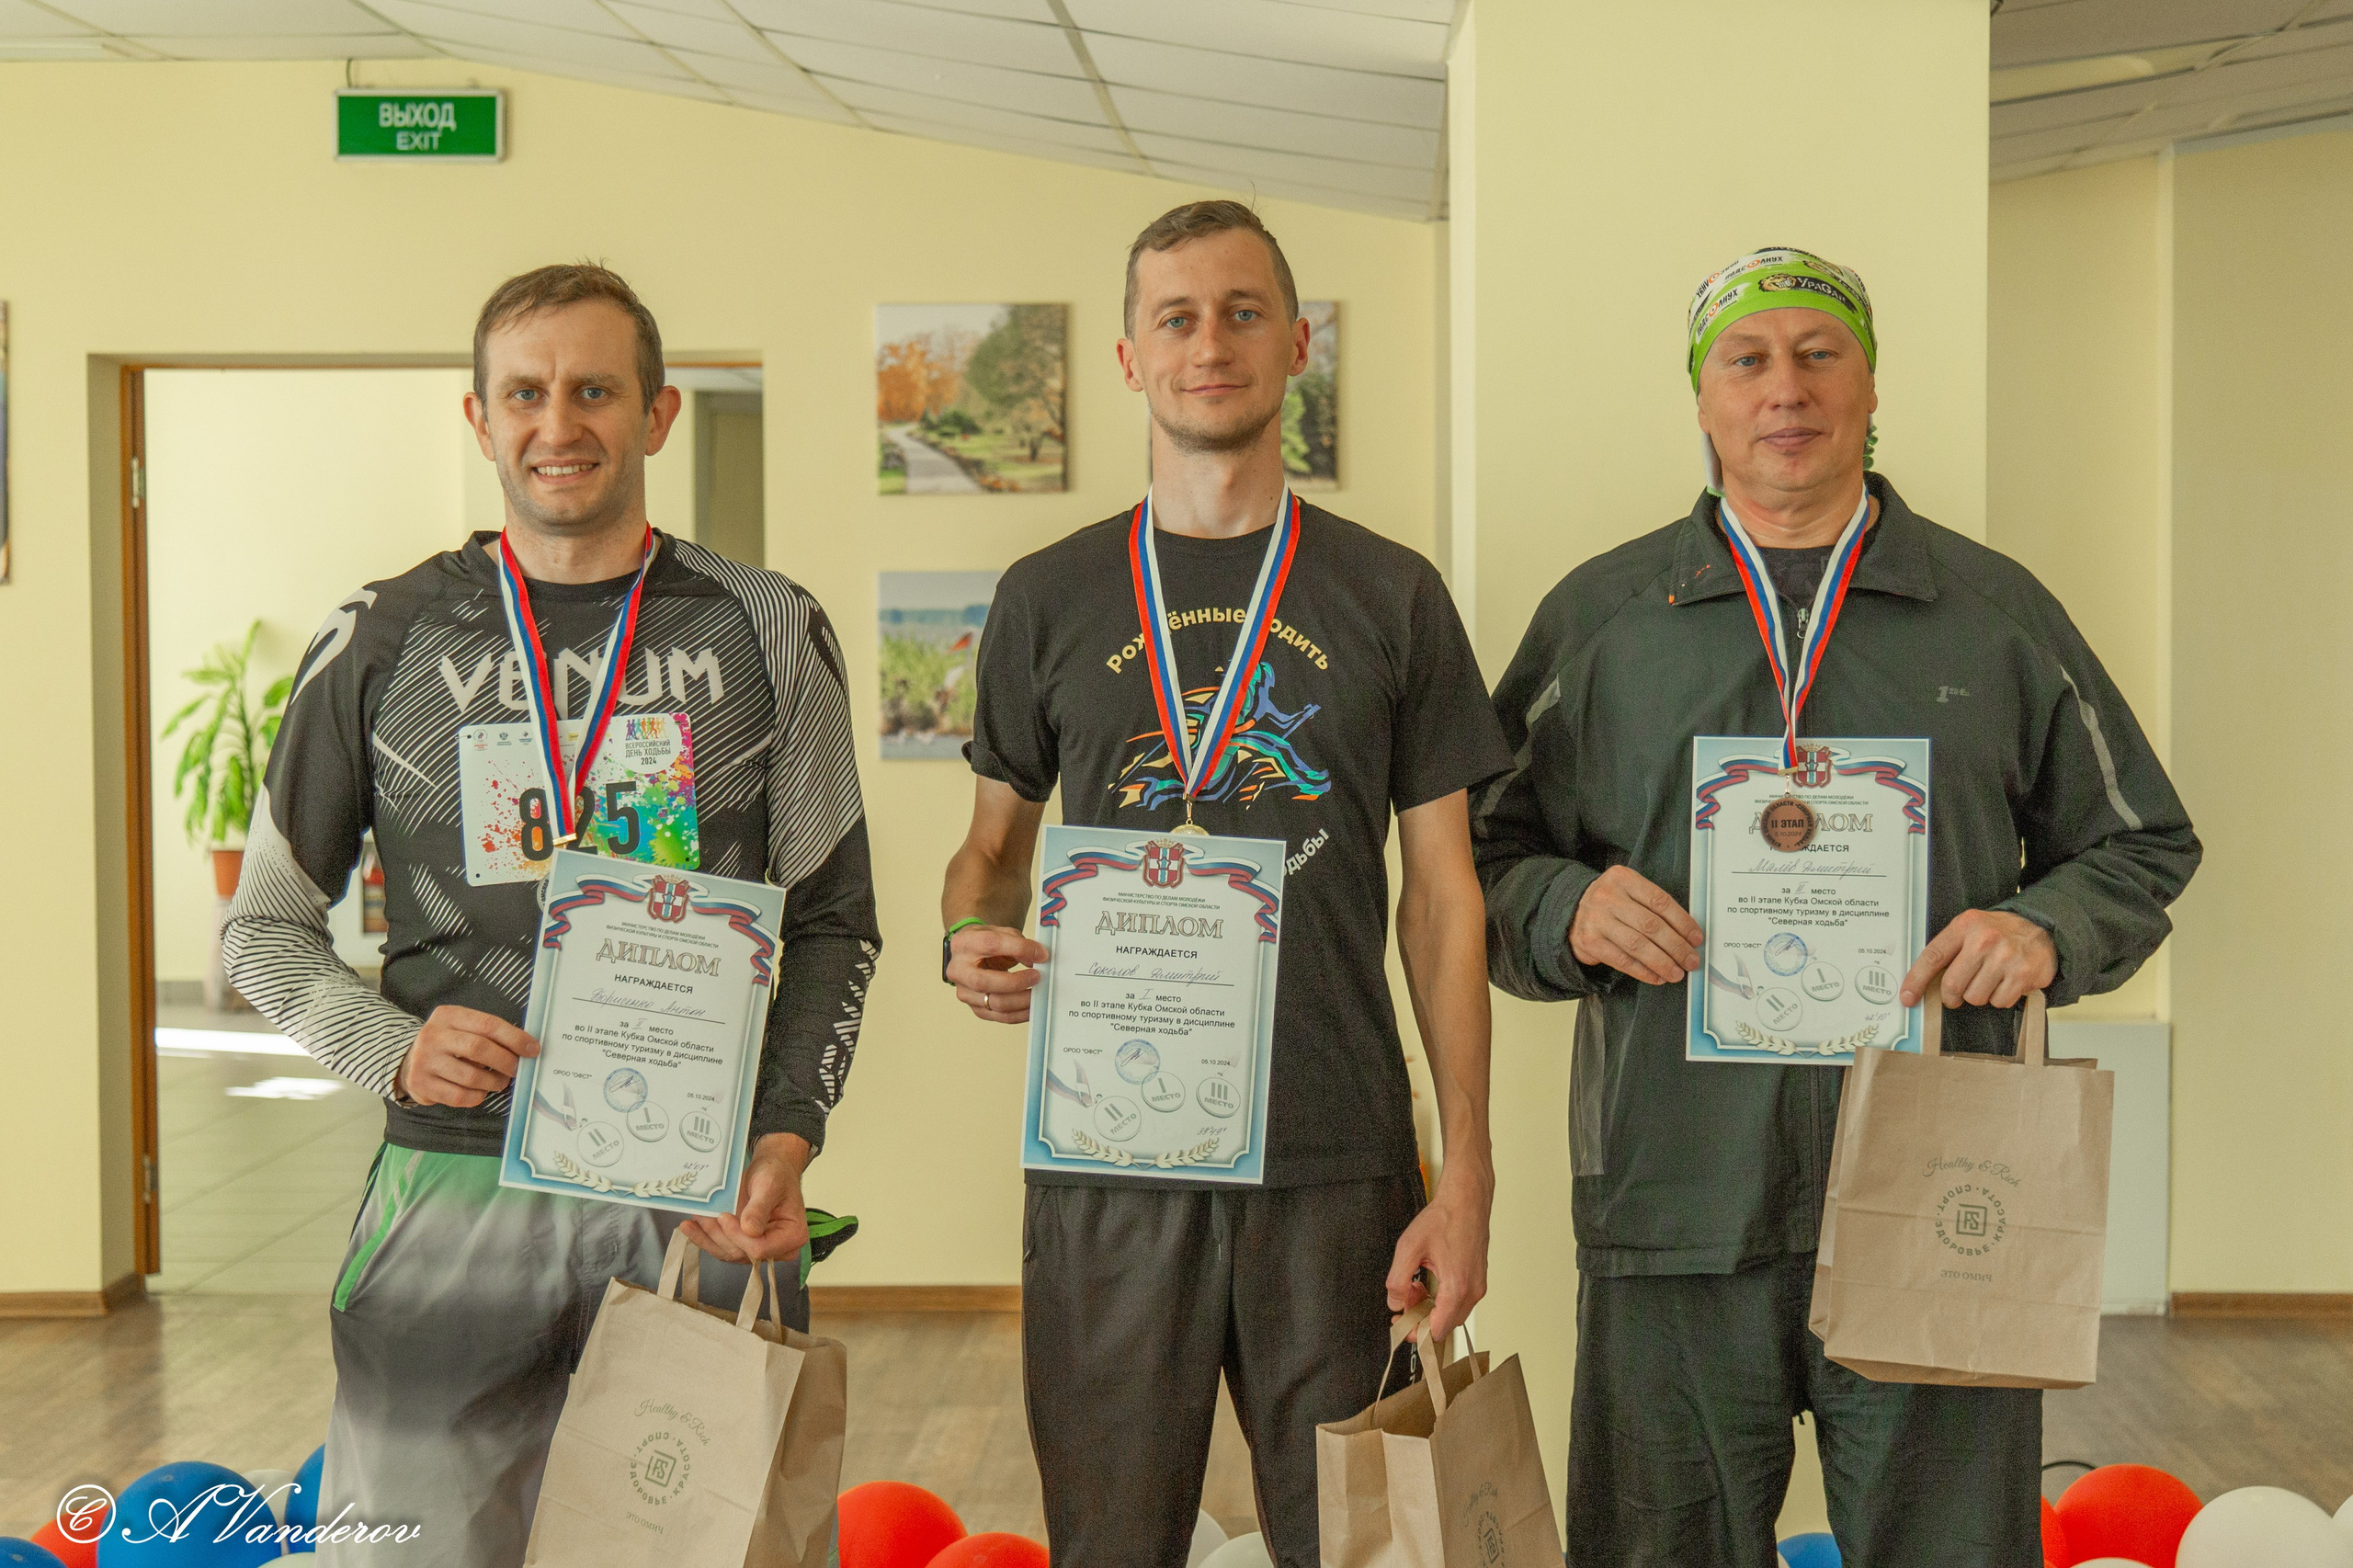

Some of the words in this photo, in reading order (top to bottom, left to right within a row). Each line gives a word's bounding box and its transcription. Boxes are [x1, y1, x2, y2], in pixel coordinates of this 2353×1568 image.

[379, 102, 457, 131] ВЫХОД
[396, 131, 442, 151] EXIT
[1270, 618, 1329, 671] одить
[625, 739, 671, 749] ВСЕРОССИЙСКИЙ
[625, 749, 642, 757] ДЕНЬ
[643, 747, 671, 756] ХОДЬБЫ
[641, 756, 657, 765] 2024
[519, 781, 641, 861] 825
[1748, 810, 1873, 835] ДЛОМ
[1771, 820, 1778, 829] II
[1780, 819, 1804, 829] ЭТАП
[1284, 828, 1329, 876] дьбы
[1784, 896, 1808, 905] Кубка
[1810, 897, 1842, 905] Омской
[1844, 898, 1879, 906] области
[1739, 907, 1793, 915] спортивному
[1796, 908, 1829, 916] туризму
[606, 925, 635, 933] ФИЗИЧЕСКОЙ
[1094, 910, 1224, 939] ДИПЛОМ
[1768, 916, 1813, 926] "Северная
[1814, 918, 1847, 926] ходьба"
[621, 921, 656, 931] МИНИСТЕРСТВО
[679, 932, 705, 940] МОЛОДЁЖИ
[595, 937, 722, 977] ДИПЛОМ
[1116, 945, 1197, 959] НАГРАЖДАЕТСЯ
[614, 973, 693, 994] НАГРАЖДАЕТСЯ
[1811, 981, 1840, 992] МЕСТО
[1862, 983, 1893, 995] МЕСТО
[1093, 999, 1098, 1007] II
[1127, 1002, 1152, 1012] Кубка
[1154, 1004, 1188, 1013] Омской
[1189, 1006, 1224, 1016] области
[1772, 1002, 1798, 1025] МЕСТО
[1081, 1011, 1137, 1022] спортивному
[1140, 1015, 1174, 1025] туризму
[1183, 1018, 1235, 1028] дисциплине
[1109, 1022, 1155, 1033] "Северная
[1158, 1027, 1192, 1035] ходьба"
[648, 1026, 674, 1035] место
[594, 1028, 619, 1037] этапе
[620, 1030, 644, 1041] Кубка
[646, 1034, 678, 1046] Омской
[680, 1040, 714, 1052] области
[574, 1035, 629, 1051] спортивному
[631, 1044, 664, 1056] туризму
[673, 1051, 722, 1064] дисциплине
[602, 1049, 646, 1062] "Северная
[647, 1058, 681, 1068] ходьба"
[687, 1092, 715, 1101] 05.10.2024
[1151, 1092, 1181, 1103] МЕСТО
[1203, 1096, 1234, 1109] МЕСТО
[635, 1122, 664, 1131] МЕСТО
[1109, 1112, 1137, 1134] МЕСТО
[686, 1130, 715, 1144] МЕСТО
[591, 1140, 620, 1160] МЕСТО
[1979, 1160, 1992, 1172] &
[1937, 1184, 1972, 1212] СПОРТ
[1982, 1187, 2006, 1242] КРАСОТА
[1935, 1221, 1990, 1256] ЗДОРОВЬЕ
[680, 1413, 693, 1424] &
[636, 1432, 670, 1454] СПОРТ
[673, 1439, 690, 1496] КРАСОТА
[630, 1461, 667, 1506] ЗДОРОВЬЕ
